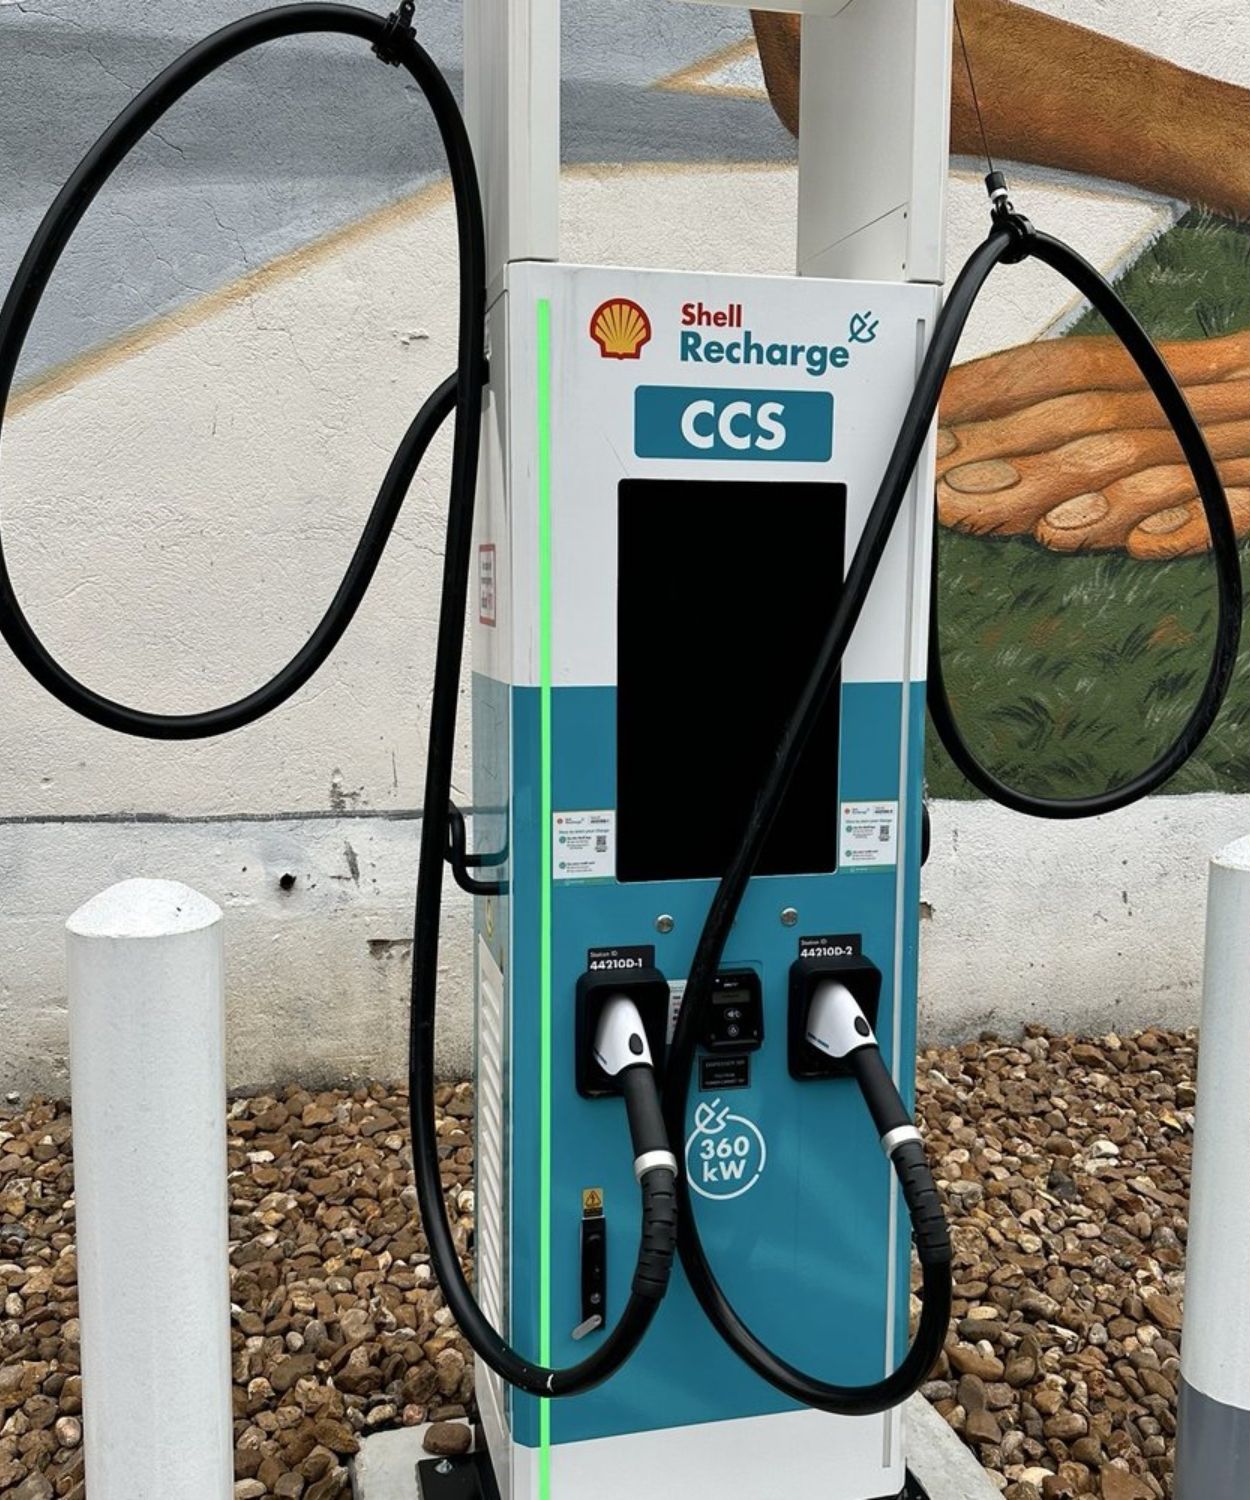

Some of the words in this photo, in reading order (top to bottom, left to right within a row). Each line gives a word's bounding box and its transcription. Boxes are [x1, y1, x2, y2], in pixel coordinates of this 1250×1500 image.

[681, 303, 742, 328] Shell
[679, 330, 850, 376] Recharge
[681, 399, 786, 451] CCS
[801, 945, 853, 958] 44210D-2
[589, 957, 643, 971] 44210D-1
[700, 1136, 750, 1160] 360
[702, 1159, 746, 1183] kW
